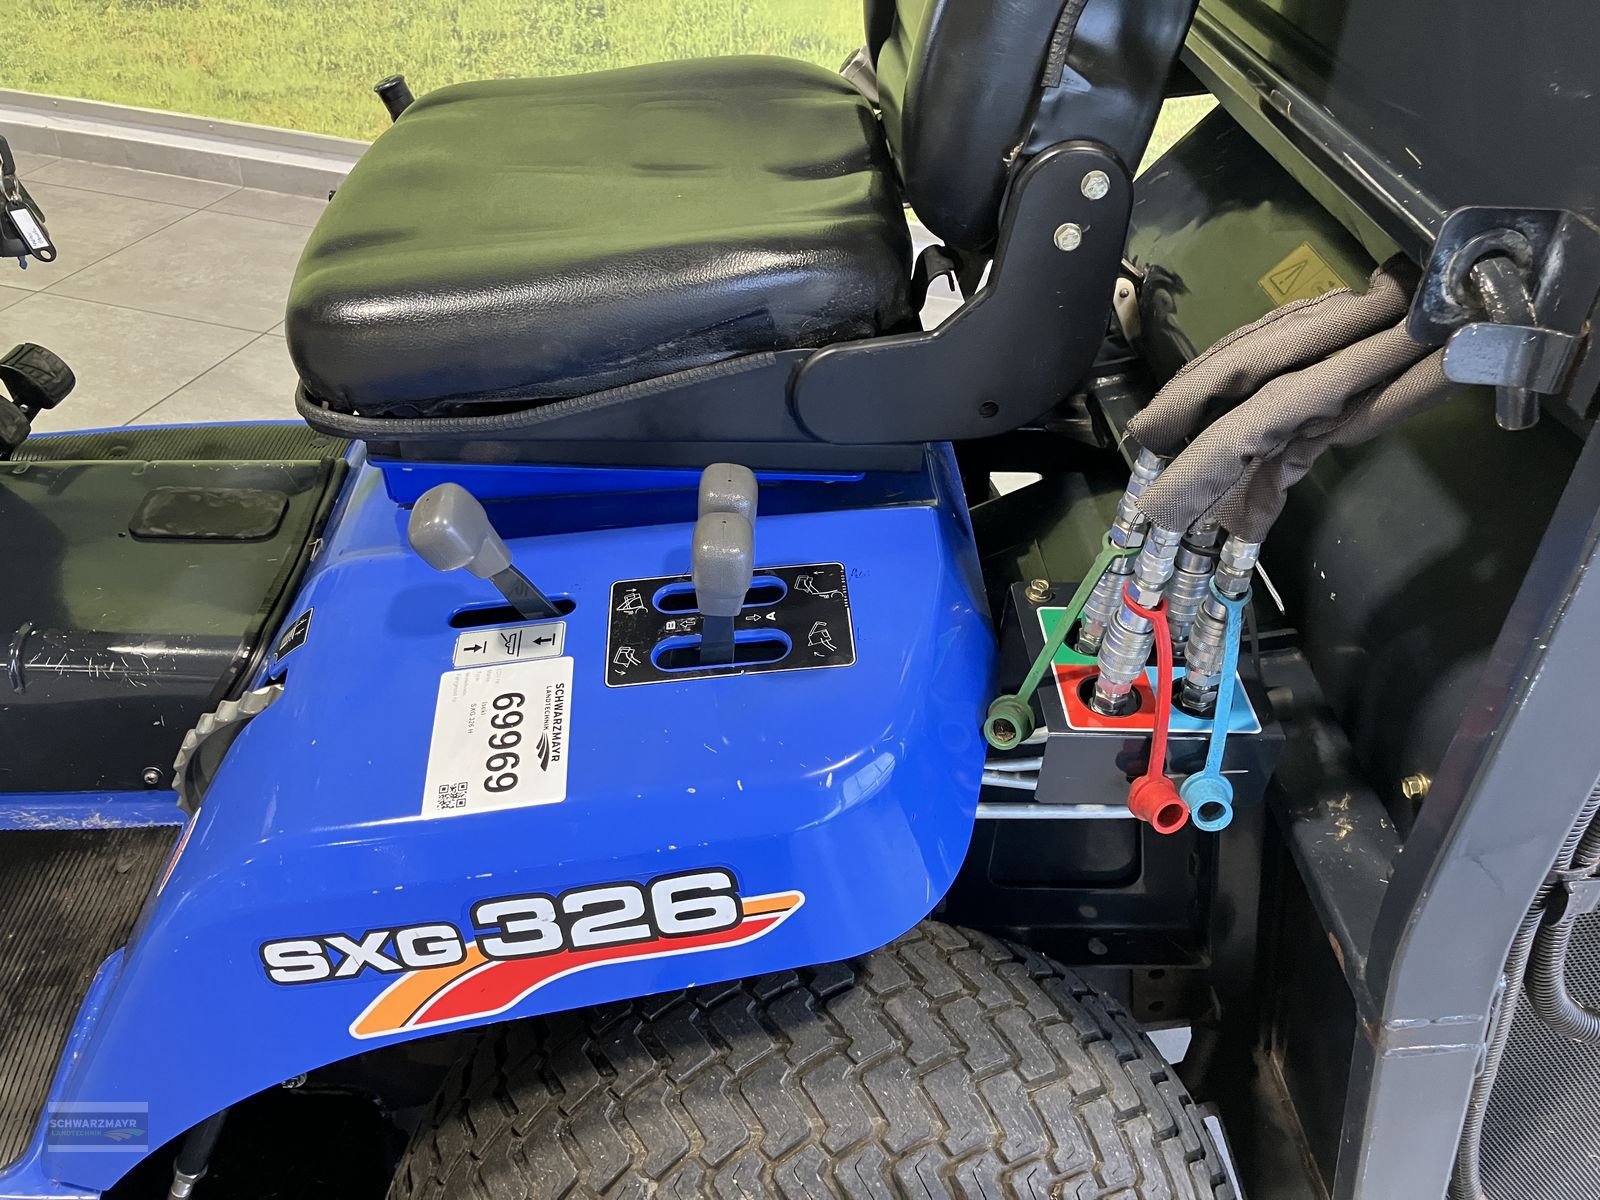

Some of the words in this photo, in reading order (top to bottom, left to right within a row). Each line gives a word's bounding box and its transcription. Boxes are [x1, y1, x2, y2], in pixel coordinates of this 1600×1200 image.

[665, 620, 676, 630] B
[766, 611, 776, 621] A
[543, 685, 552, 731] LANDTECHNIK
[550, 683, 565, 762] SCHWARZMAYR
[484, 692, 525, 793] 69969
[262, 924, 464, 983] SXG
[474, 870, 738, 958] 326
